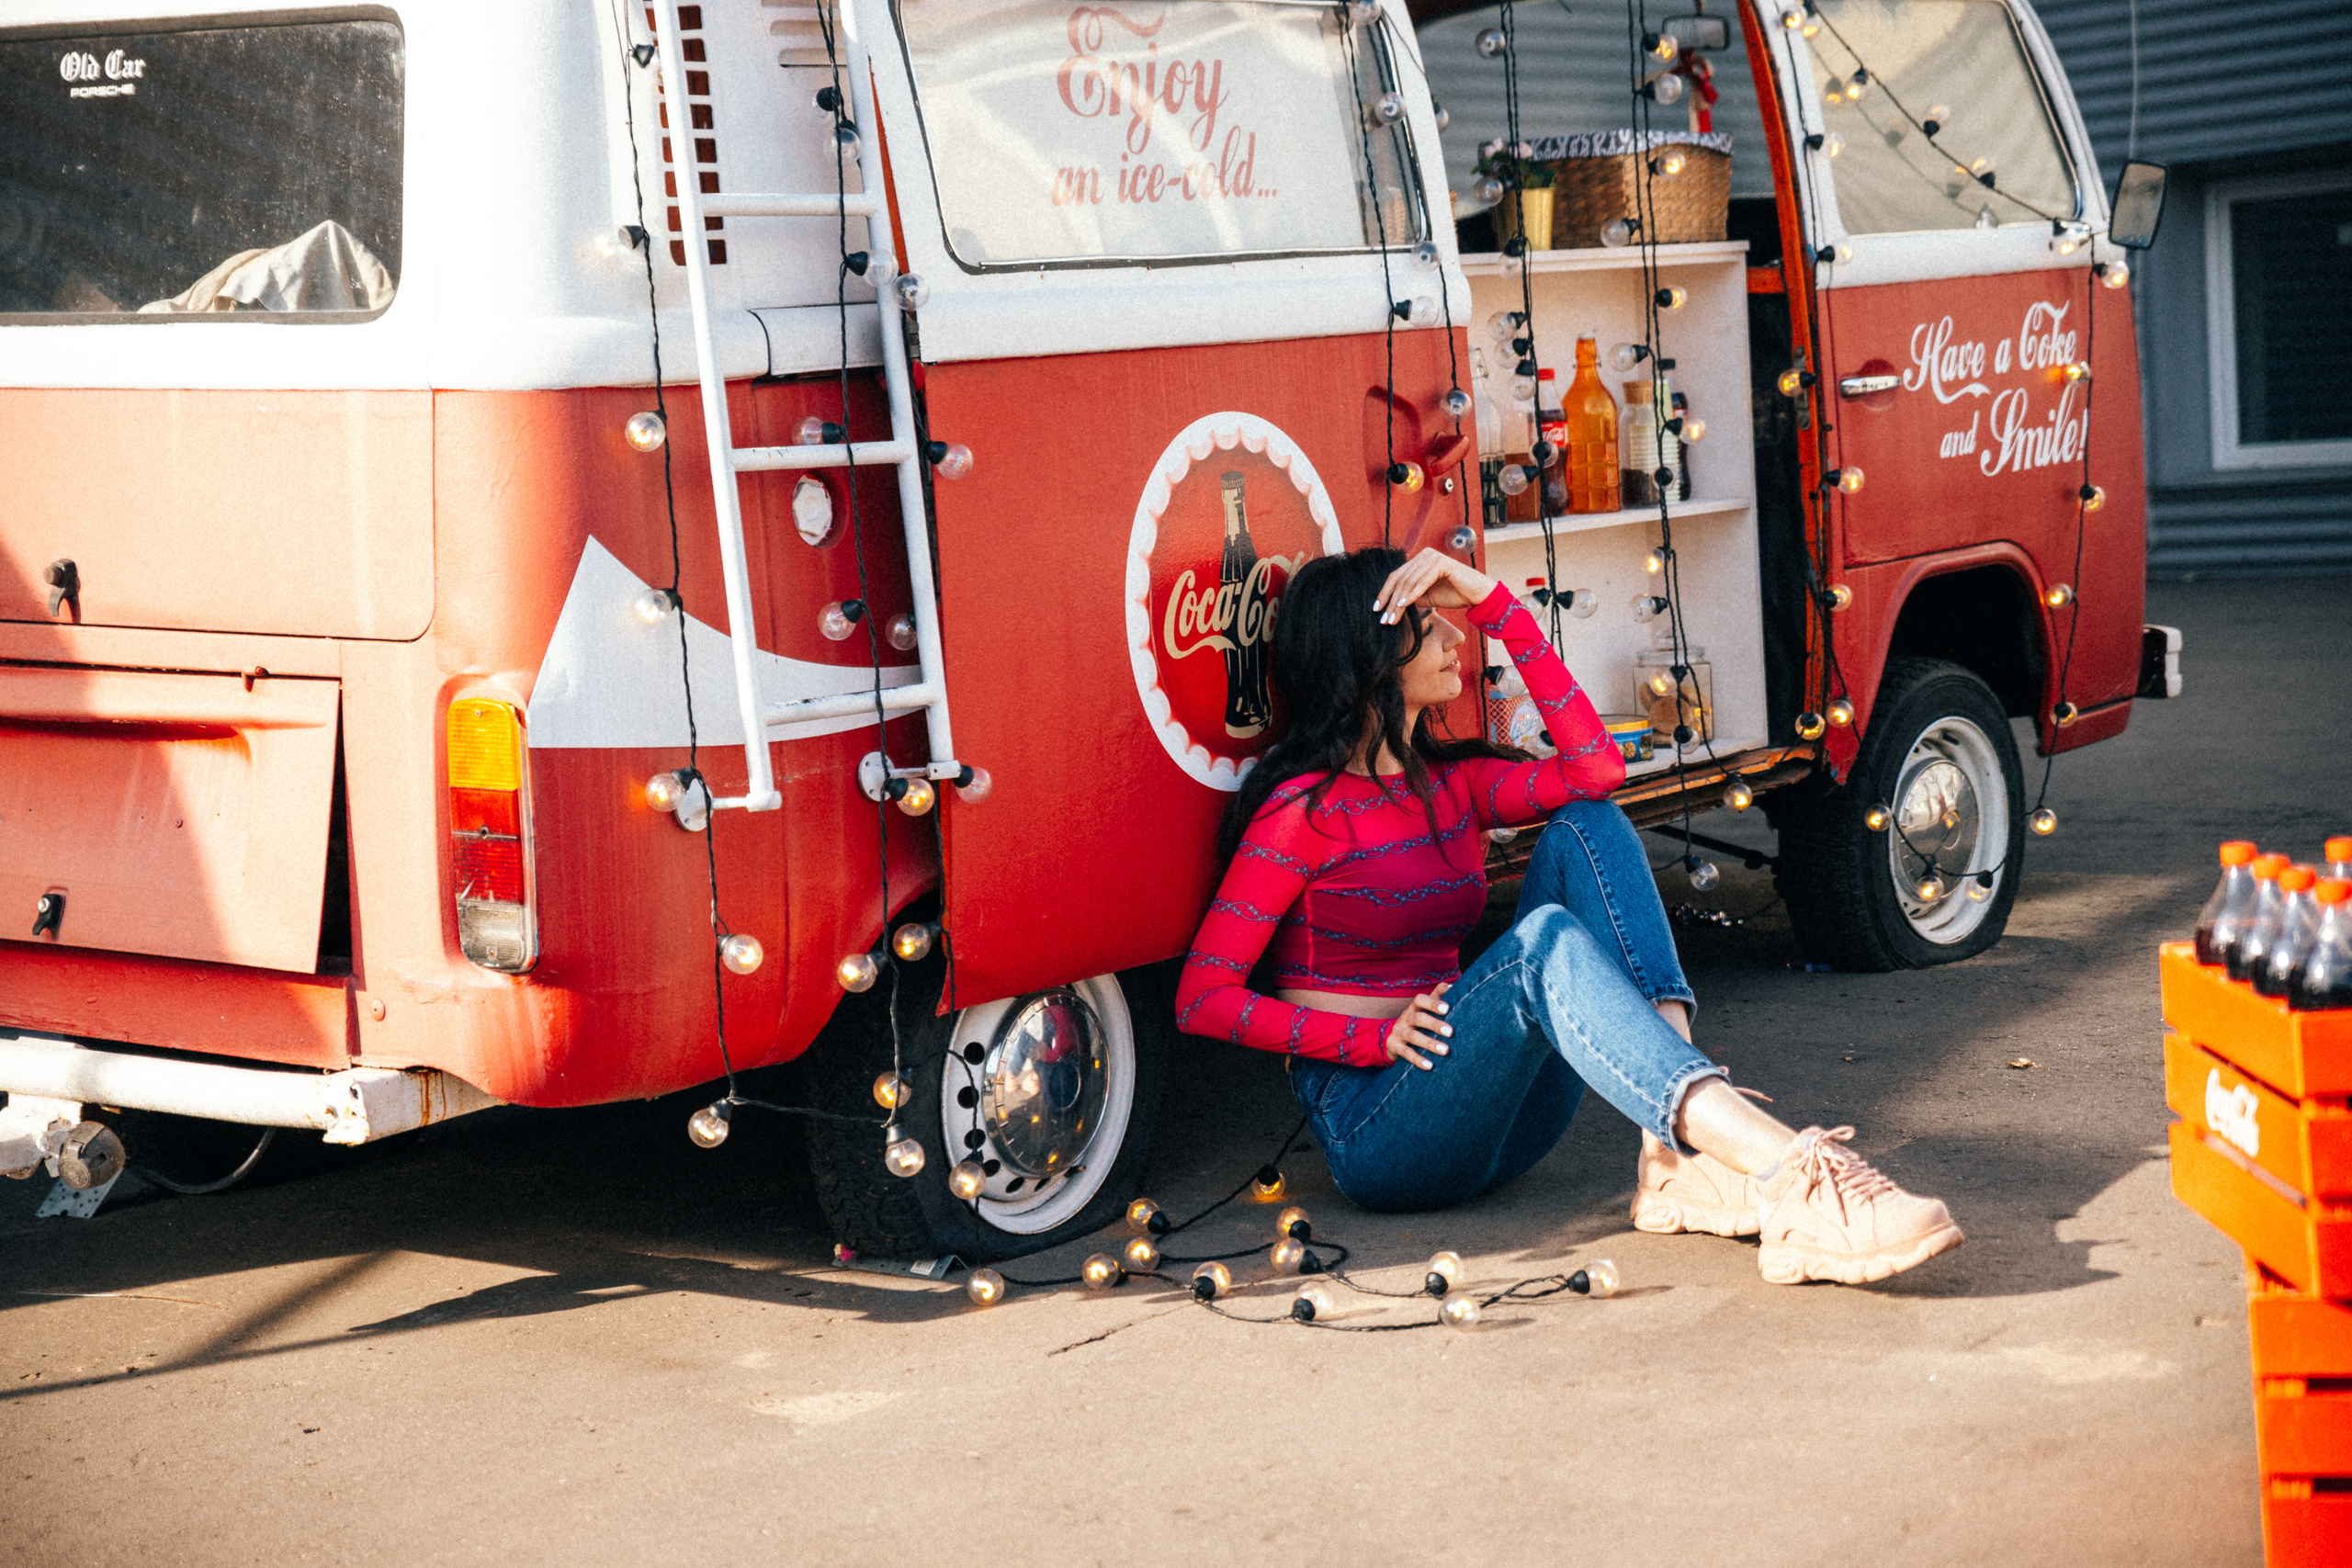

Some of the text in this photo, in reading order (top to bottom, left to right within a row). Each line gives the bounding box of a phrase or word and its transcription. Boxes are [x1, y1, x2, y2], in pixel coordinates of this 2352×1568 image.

[60, 49, 147, 83] Old Car
[70, 83, 136, 99] PORSCHE
[1057, 6, 1229, 155] Enjoy
[1051, 125, 1277, 207] an ice-cold...
[1903, 299, 2076, 404] Have a Coke
[1939, 384, 2088, 478] and Smile!
